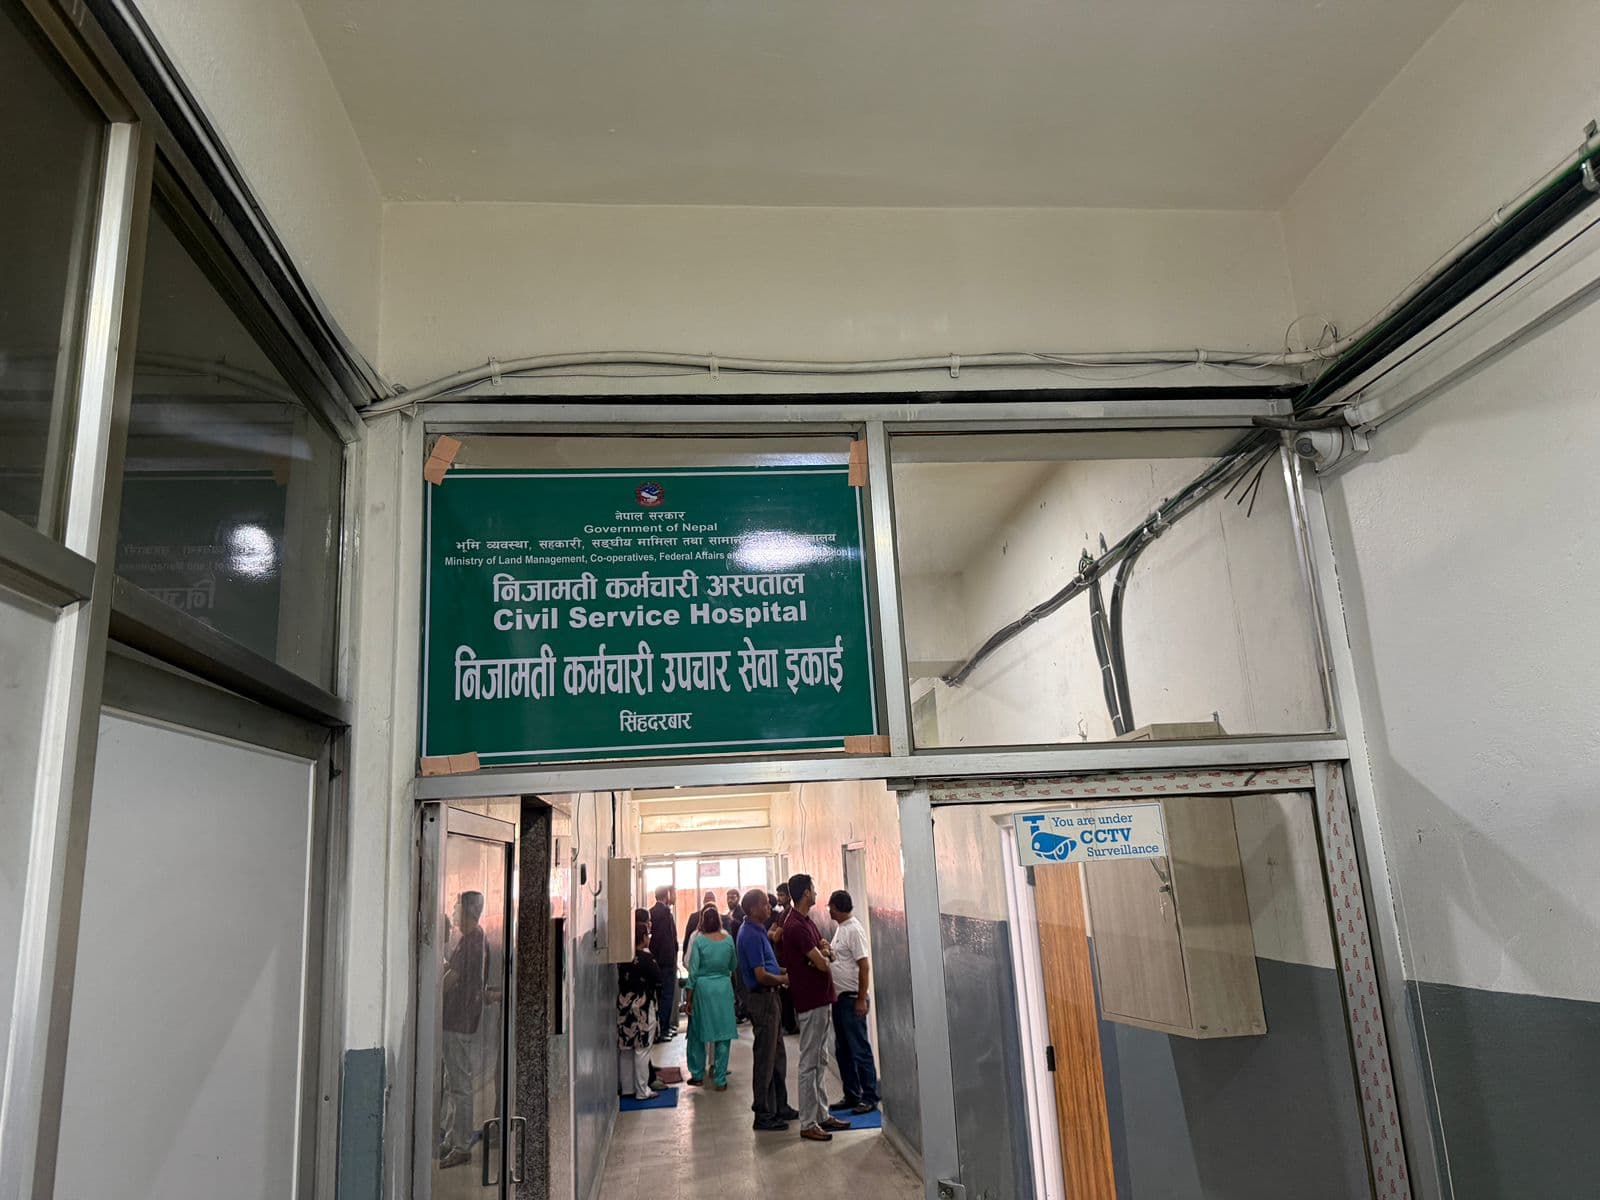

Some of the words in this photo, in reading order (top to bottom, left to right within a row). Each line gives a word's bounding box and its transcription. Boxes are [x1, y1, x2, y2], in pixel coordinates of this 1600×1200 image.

[615, 510, 644, 521] नेपाल
[648, 511, 686, 521] सरकार
[584, 524, 662, 534] Government
[666, 523, 678, 532] of
[682, 523, 718, 533] Nepal
[456, 538, 481, 553] भूमि
[486, 540, 532, 551] व्यवस्था,
[539, 537, 585, 550] सहकारी,
[637, 535, 678, 547] मामिला
[682, 536, 704, 546] तथा
[444, 556, 483, 567] Ministry
[486, 555, 496, 565] of
[498, 555, 522, 565] Land
[525, 554, 588, 566] Management,
[590, 553, 657, 564] Co-operatives,
[660, 551, 693, 561] Federal
[695, 550, 725, 560] Affairs
[493, 571, 598, 602] निजामती
[605, 569, 699, 599] कर्मचारी
[706, 573, 805, 597] अस्पताल
[493, 607, 558, 631] Civil
[568, 605, 680, 629] Service
[690, 600, 807, 628] Hospital
[454, 643, 557, 701] निजामती
[563, 640, 654, 696] कर्मचारी
[660, 650, 731, 693] उपचार
[737, 636, 779, 692] सेवा
[785, 635, 844, 695] इकाई
[619, 709, 692, 732] सिंहदरबार
[1051, 817, 1073, 828] You
[1077, 818, 1095, 827] are
[1098, 813, 1133, 825] under
[1080, 827, 1132, 844] CCTV
[1087, 843, 1159, 857] Surveillance
